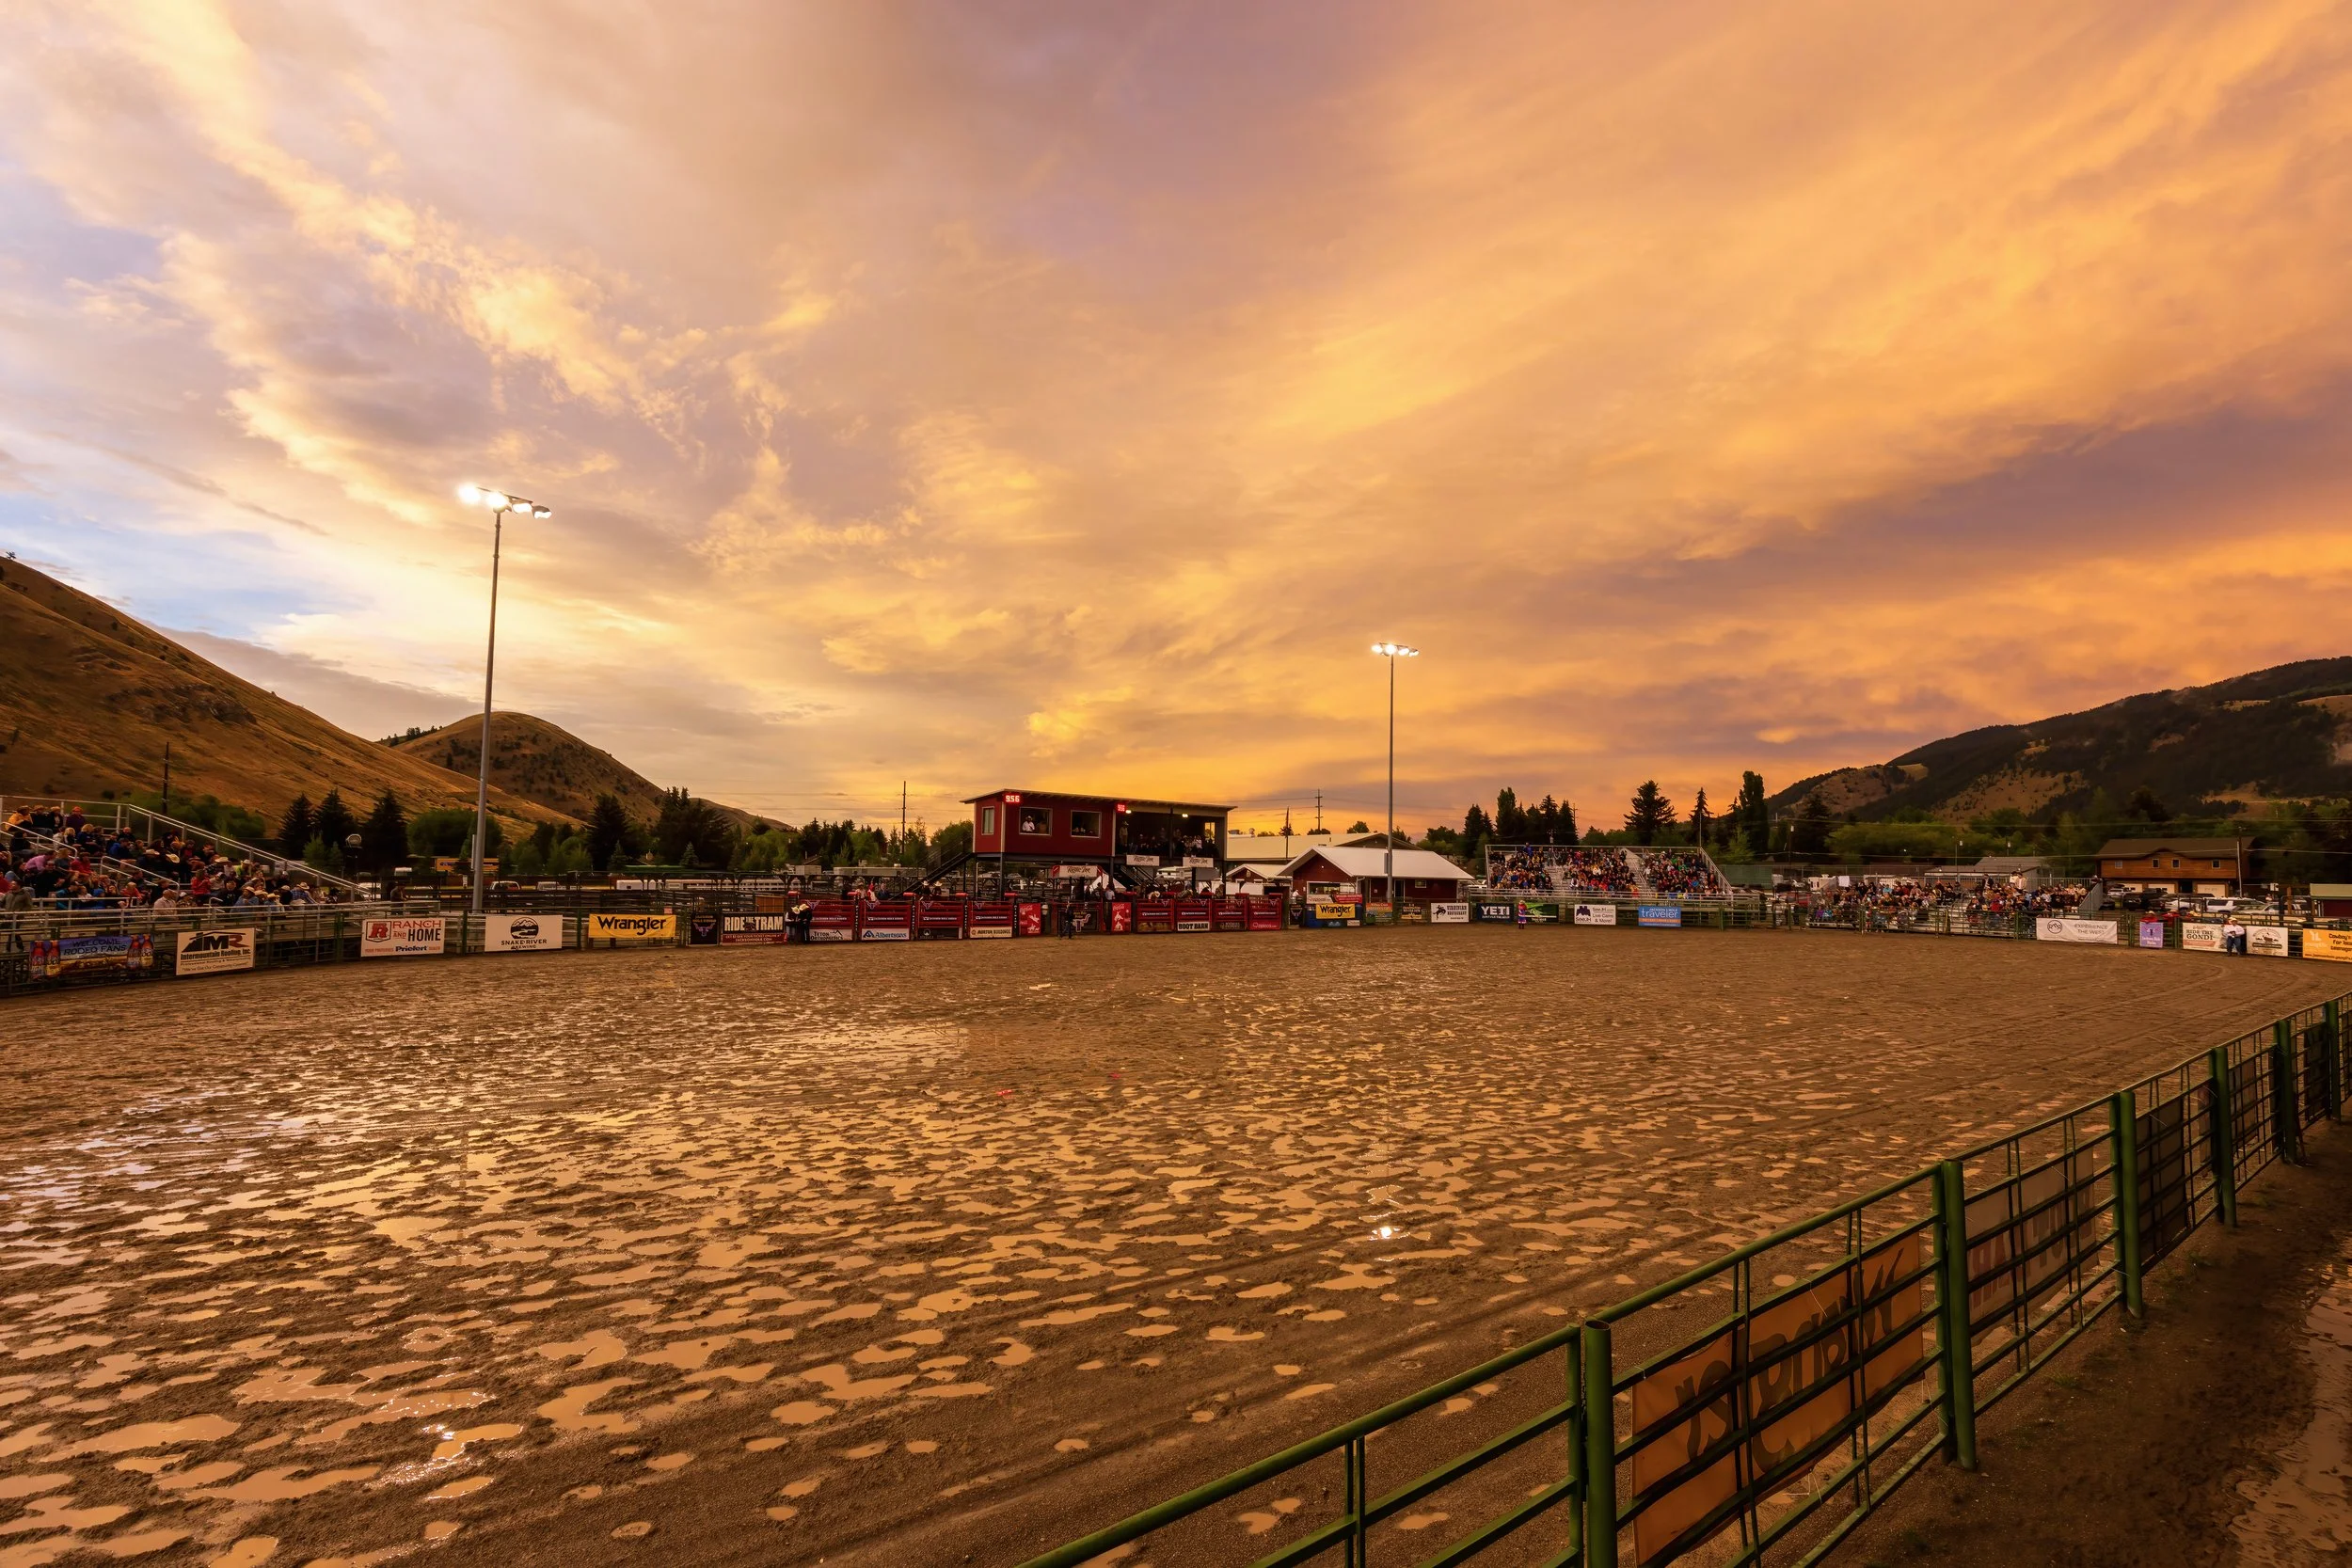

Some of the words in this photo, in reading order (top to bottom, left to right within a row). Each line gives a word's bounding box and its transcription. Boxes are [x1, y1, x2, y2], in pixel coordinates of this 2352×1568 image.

[1320, 906, 1350, 917] Wrangler
[1642, 908, 1677, 918] traveler
[393, 920, 441, 928] RANCH
[597, 916, 666, 935] Wrangler
[724, 917, 745, 931] RIDE
[755, 916, 783, 930] TRAM
[408, 928, 441, 942] HOME
[72, 939, 121, 947] WELCOME
[64, 945, 97, 955] RODEO
